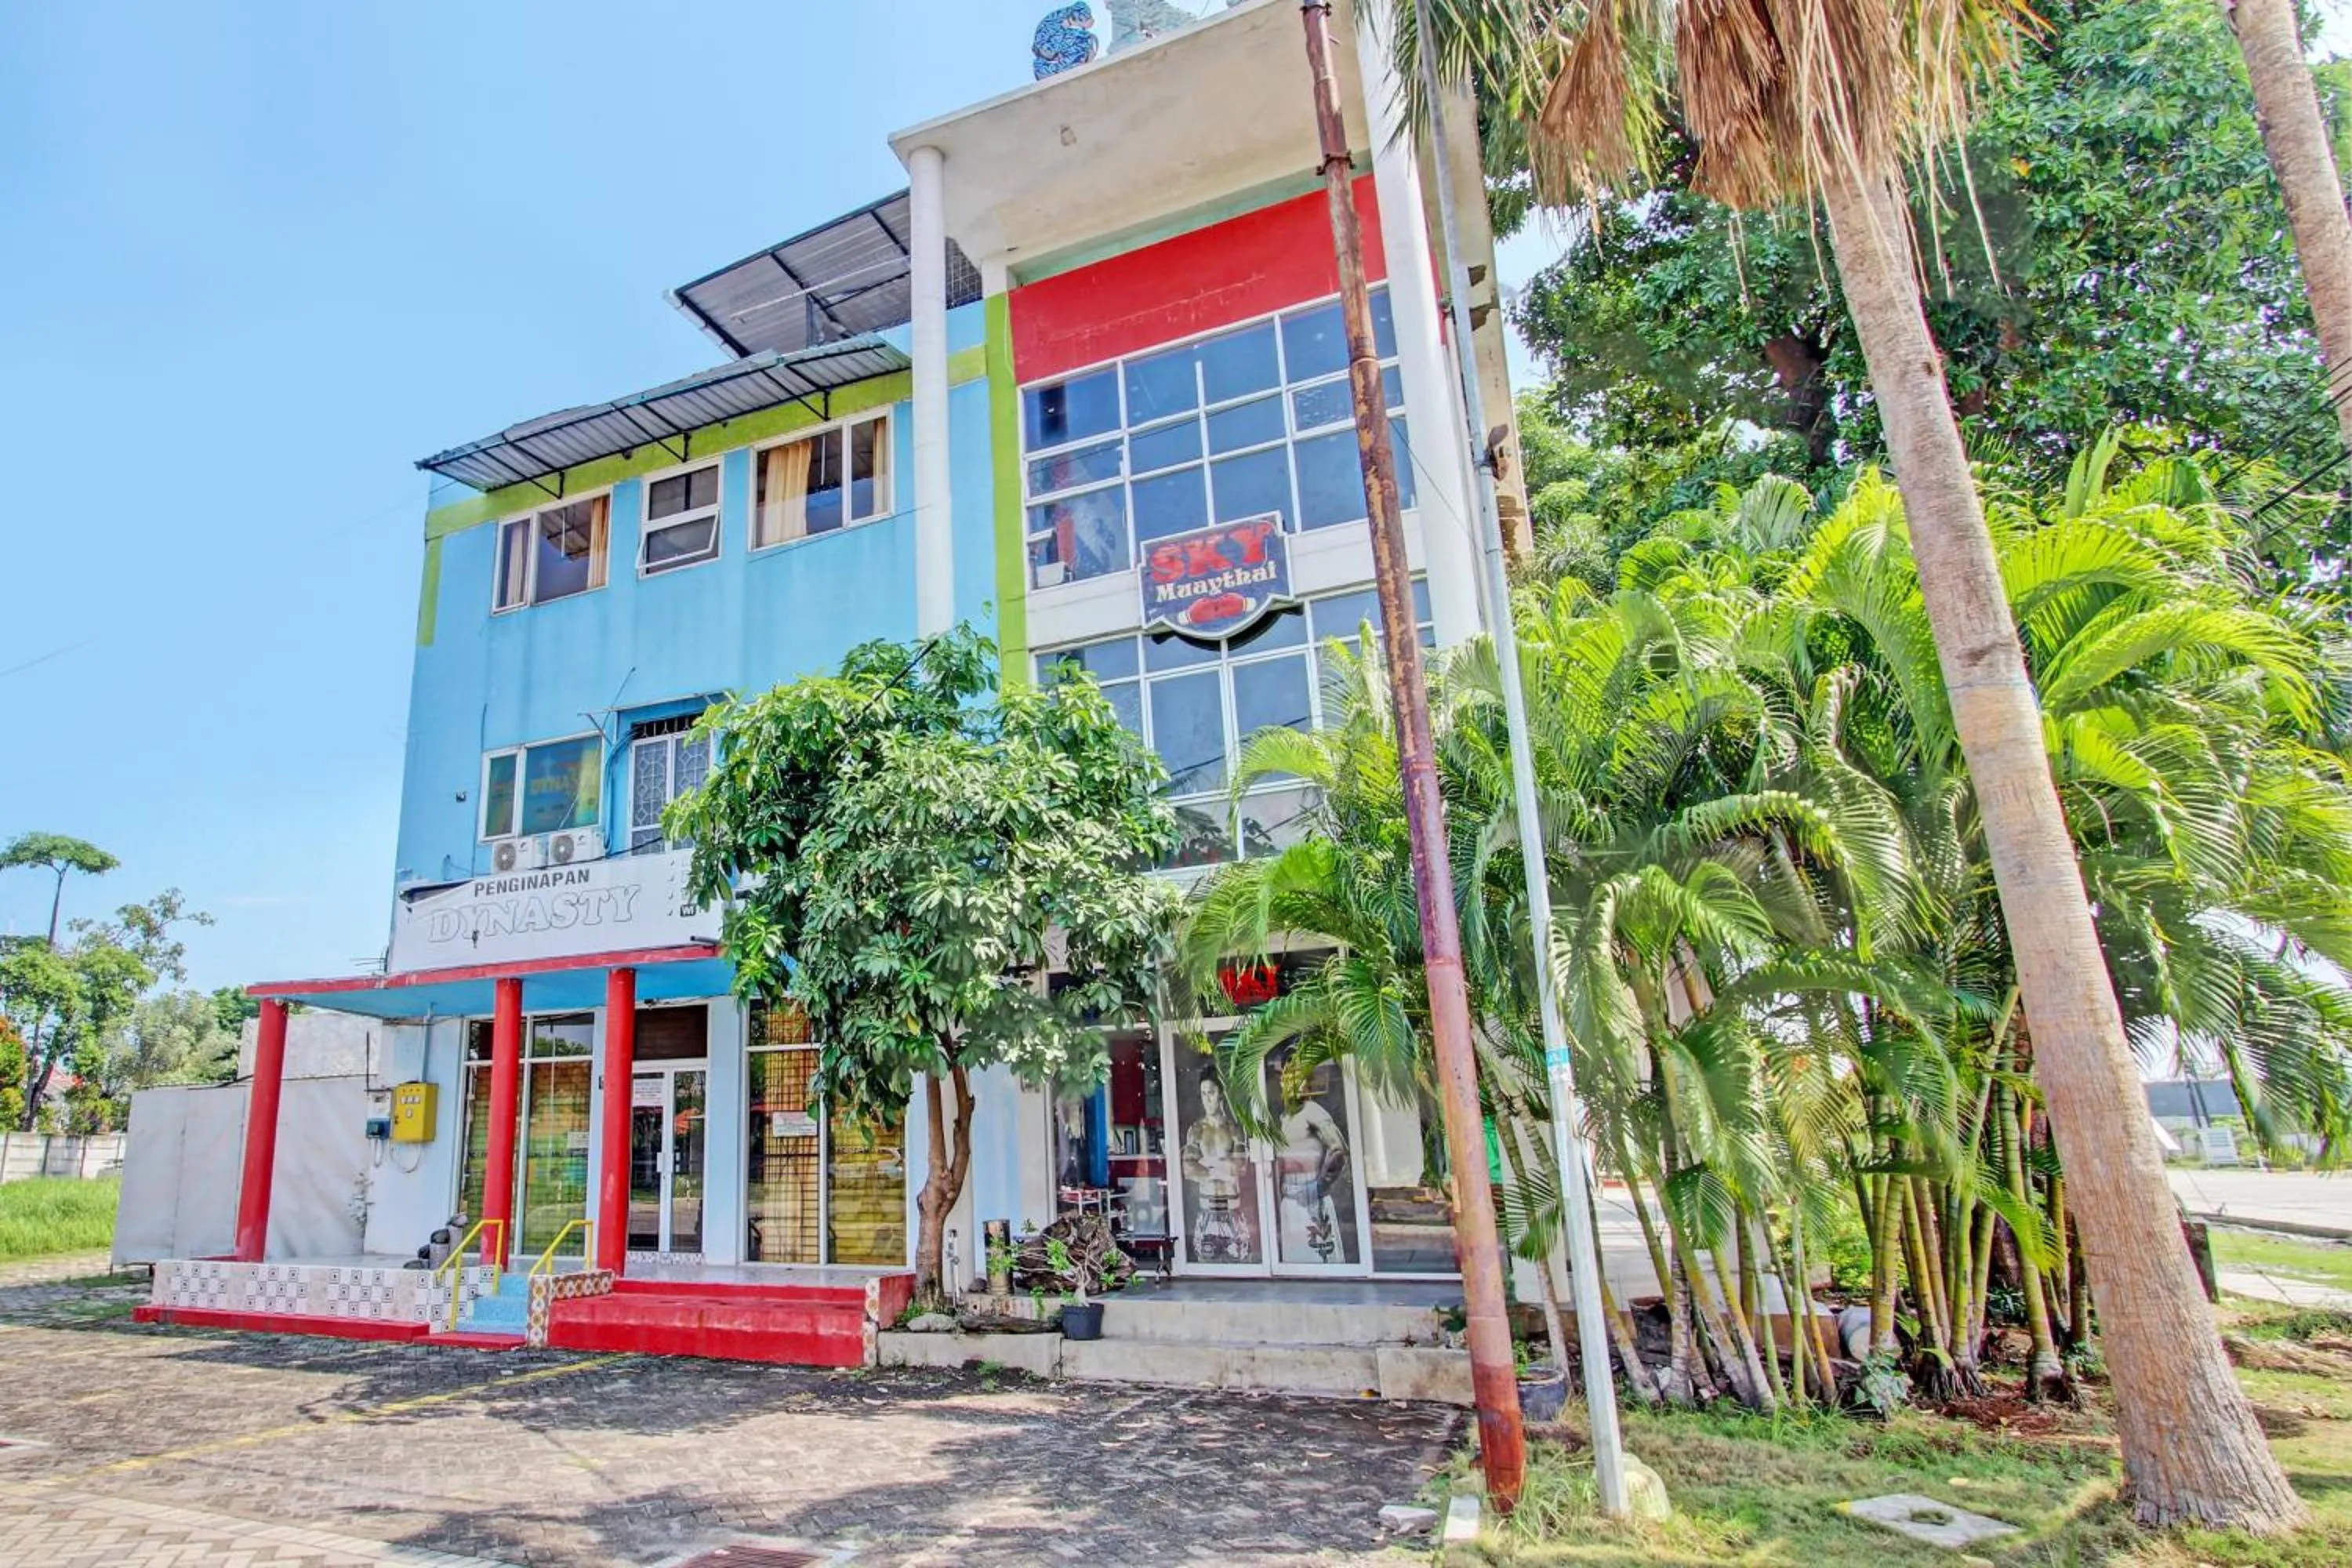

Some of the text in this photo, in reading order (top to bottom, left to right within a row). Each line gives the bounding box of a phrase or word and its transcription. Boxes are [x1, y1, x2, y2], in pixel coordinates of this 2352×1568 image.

[1151, 522, 1272, 583] SKY
[1156, 561, 1277, 602] Muaythai
[474, 869, 590, 897] PENGINAPAN
[428, 884, 641, 942] DYNASTY
